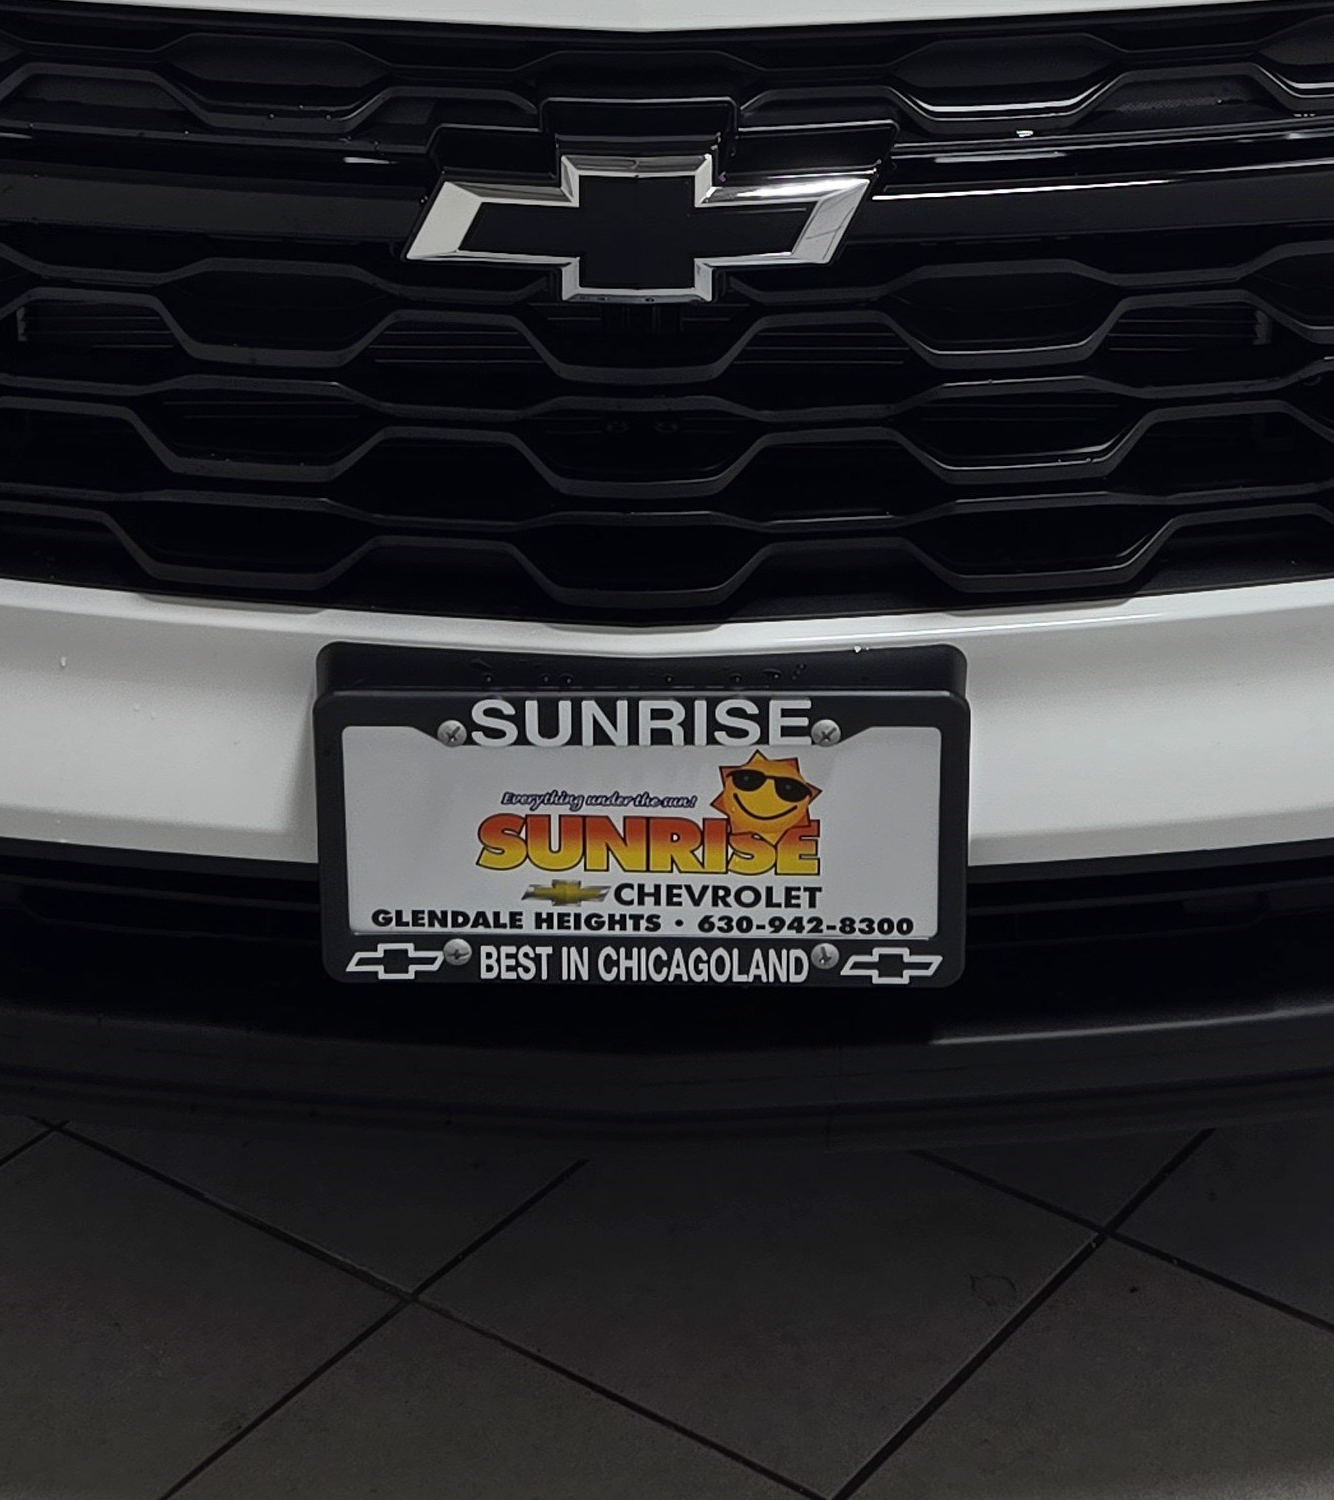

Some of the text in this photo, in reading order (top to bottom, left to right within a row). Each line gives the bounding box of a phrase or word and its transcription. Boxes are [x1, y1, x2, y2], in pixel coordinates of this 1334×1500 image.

[471, 699, 812, 747] SUNRISE
[501, 789, 698, 812] Everything under the sun!
[476, 813, 821, 876] SUNRISE
[614, 882, 822, 909] CHEVROLET
[371, 908, 914, 936] GLENDALE HEIGHTS 630-942-8300
[480, 944, 809, 984] BEST IN CHICAGOLAND
